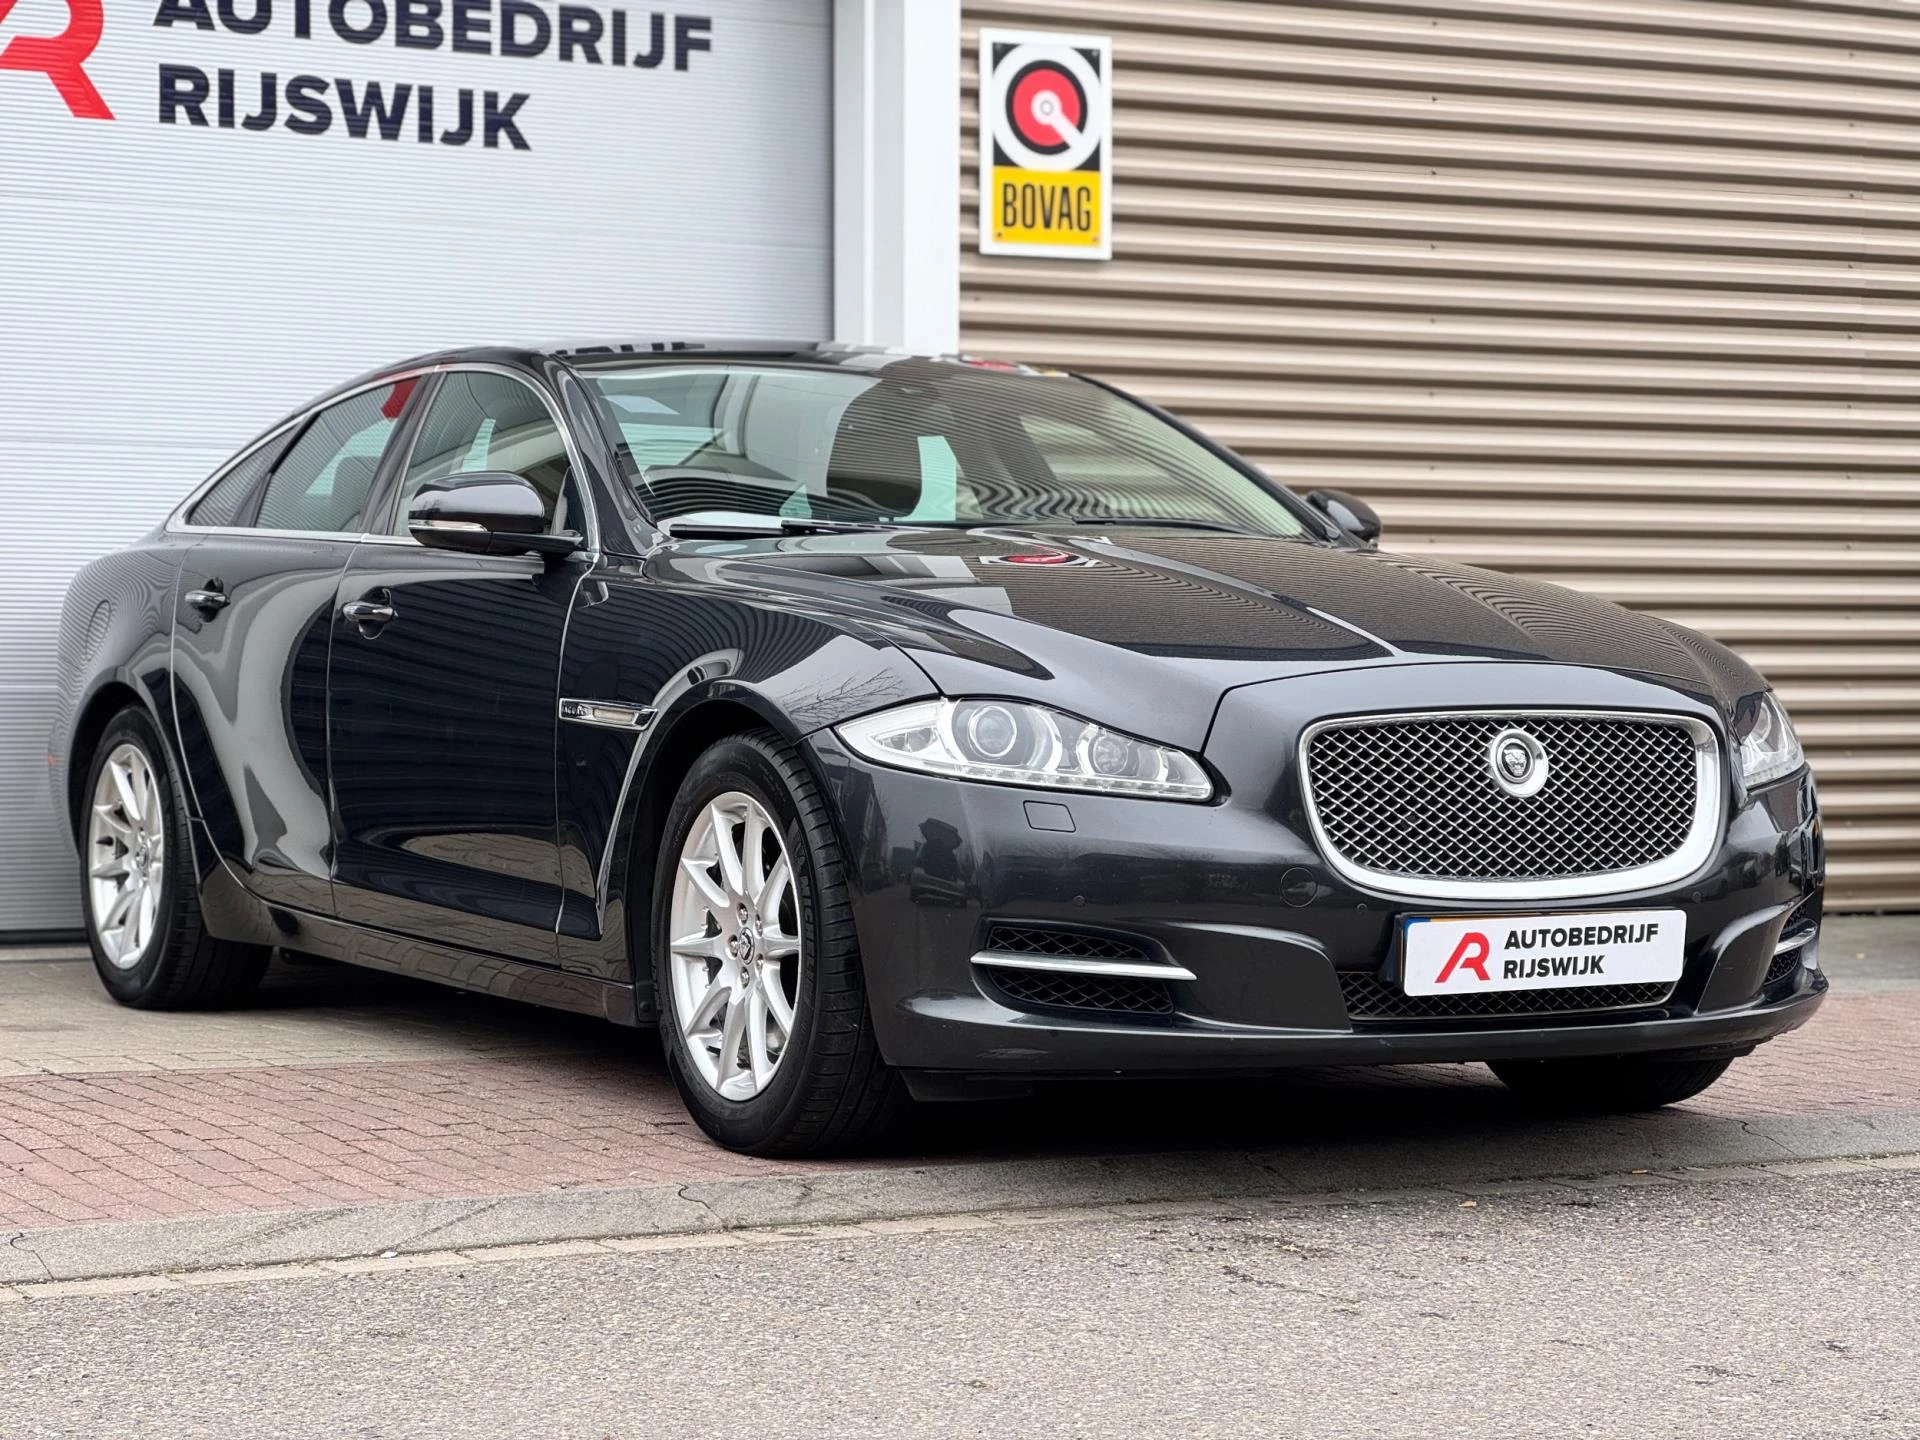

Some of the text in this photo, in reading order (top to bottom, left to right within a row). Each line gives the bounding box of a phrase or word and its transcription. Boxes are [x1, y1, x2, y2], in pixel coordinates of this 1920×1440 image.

[159, 63, 532, 151] RIJSWIJK
[1003, 183, 1091, 231] BOVAG
[1504, 923, 1659, 950] AUTOBEDRIJF
[1503, 955, 1606, 979] RIJSWIJK
